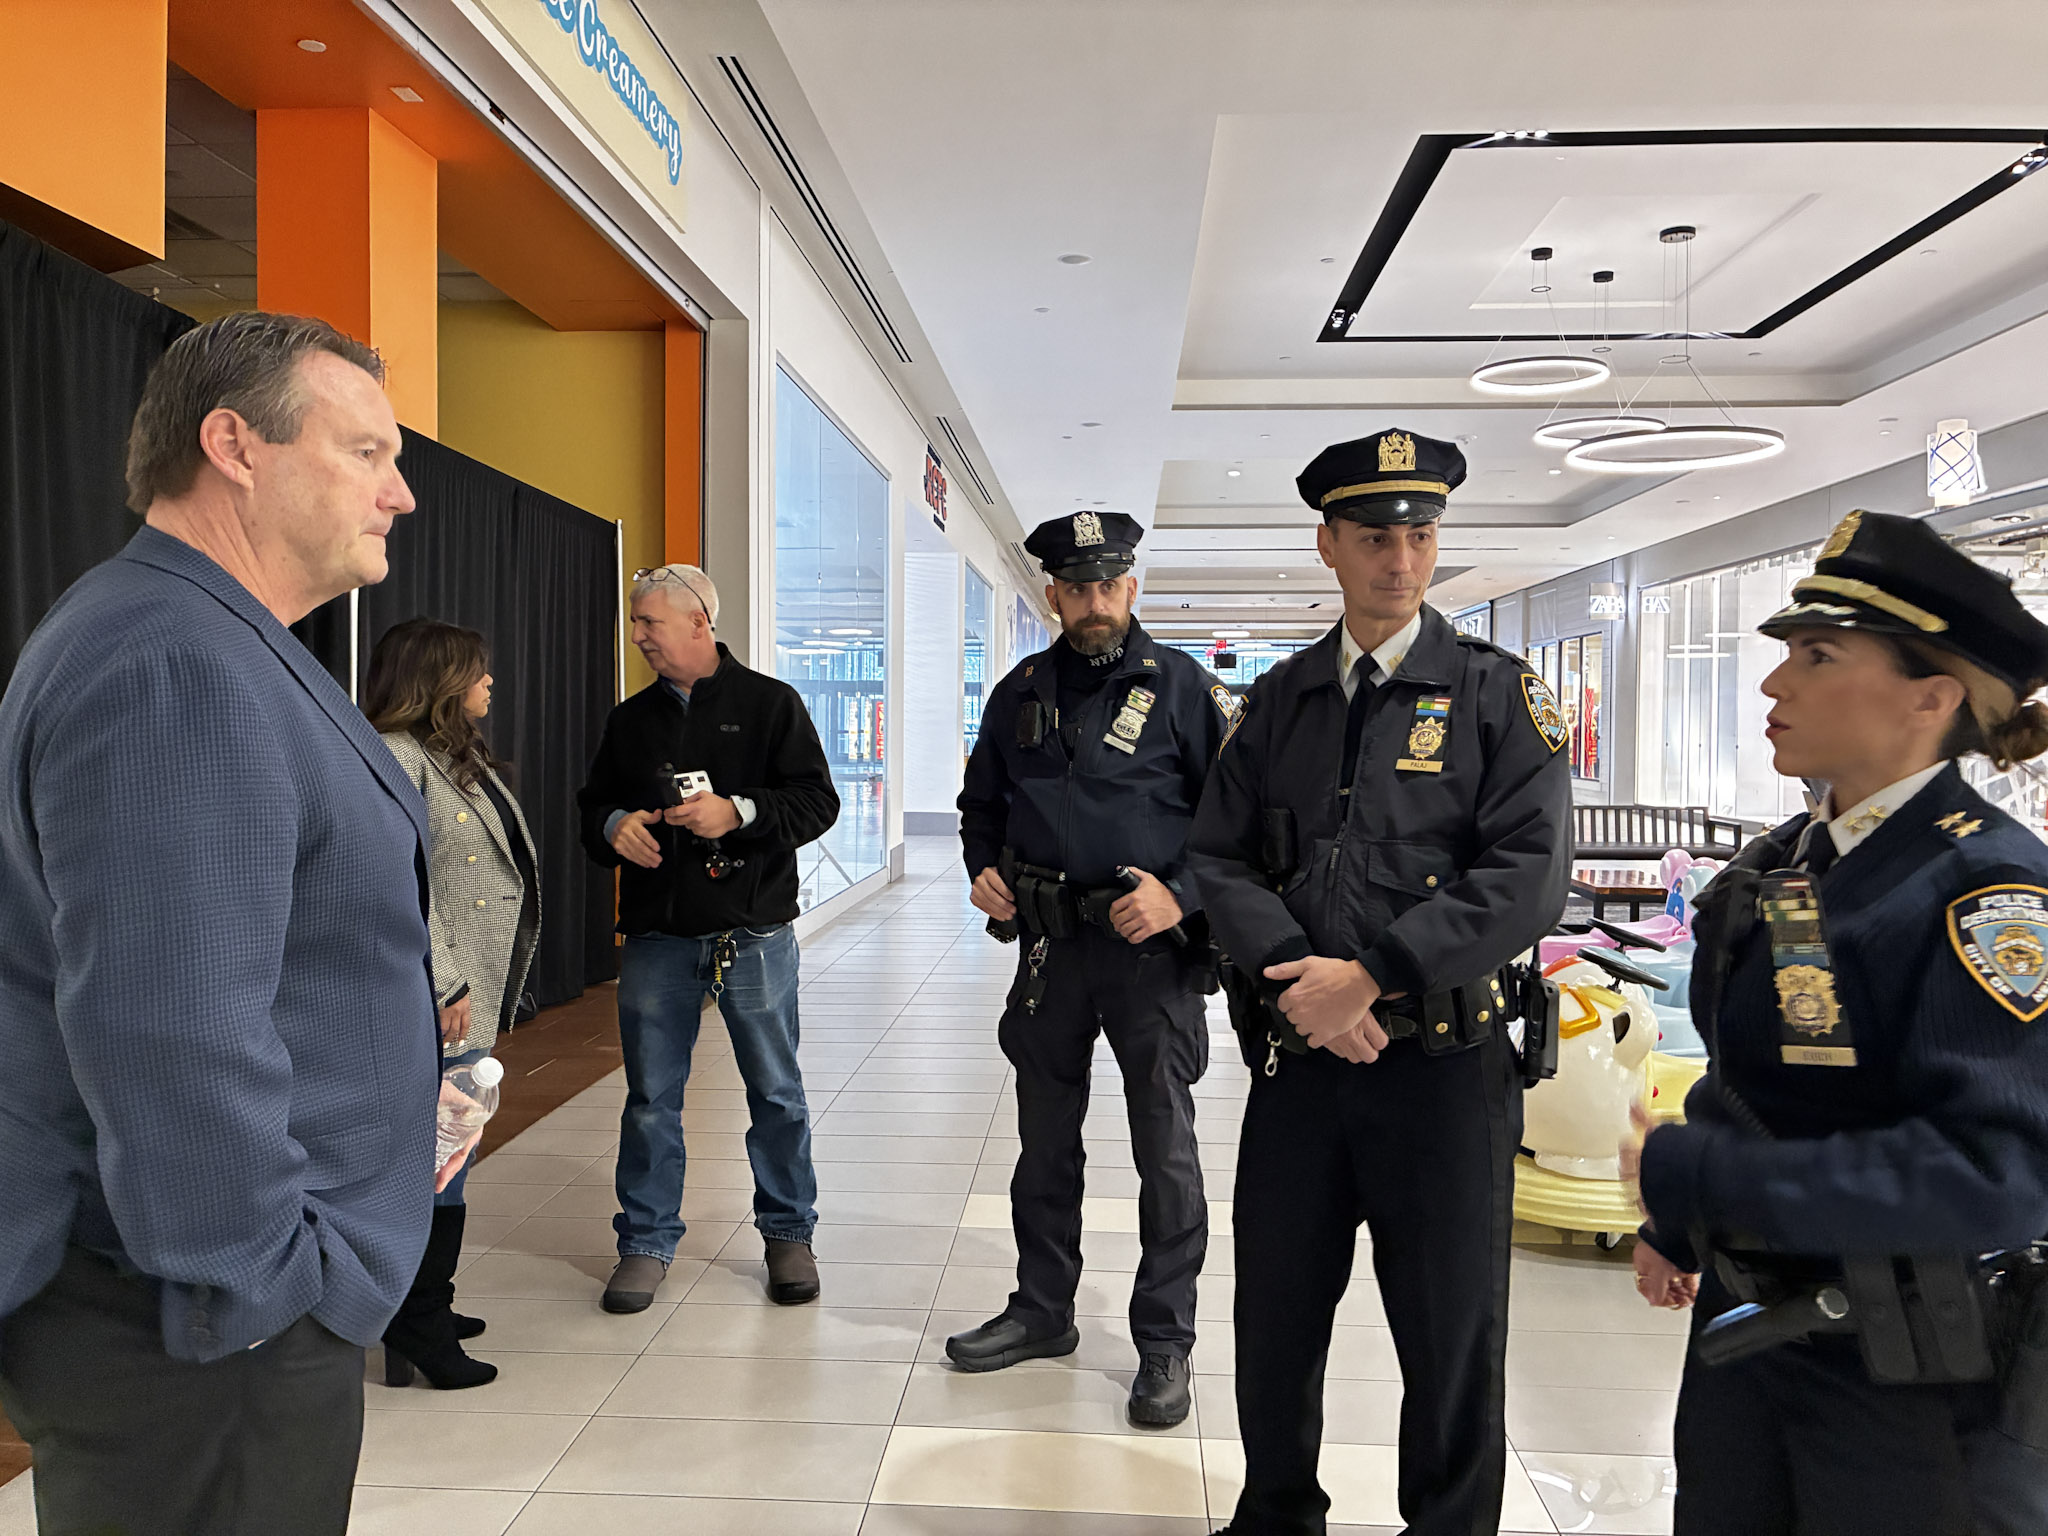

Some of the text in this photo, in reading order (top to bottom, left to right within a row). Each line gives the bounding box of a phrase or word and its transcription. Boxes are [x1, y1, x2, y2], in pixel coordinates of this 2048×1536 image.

[579, 0, 680, 176] Creamery
[1590, 595, 1625, 613] ZARA
[1089, 647, 1124, 666] NYPD
[1978, 894, 2043, 909] POLICE
